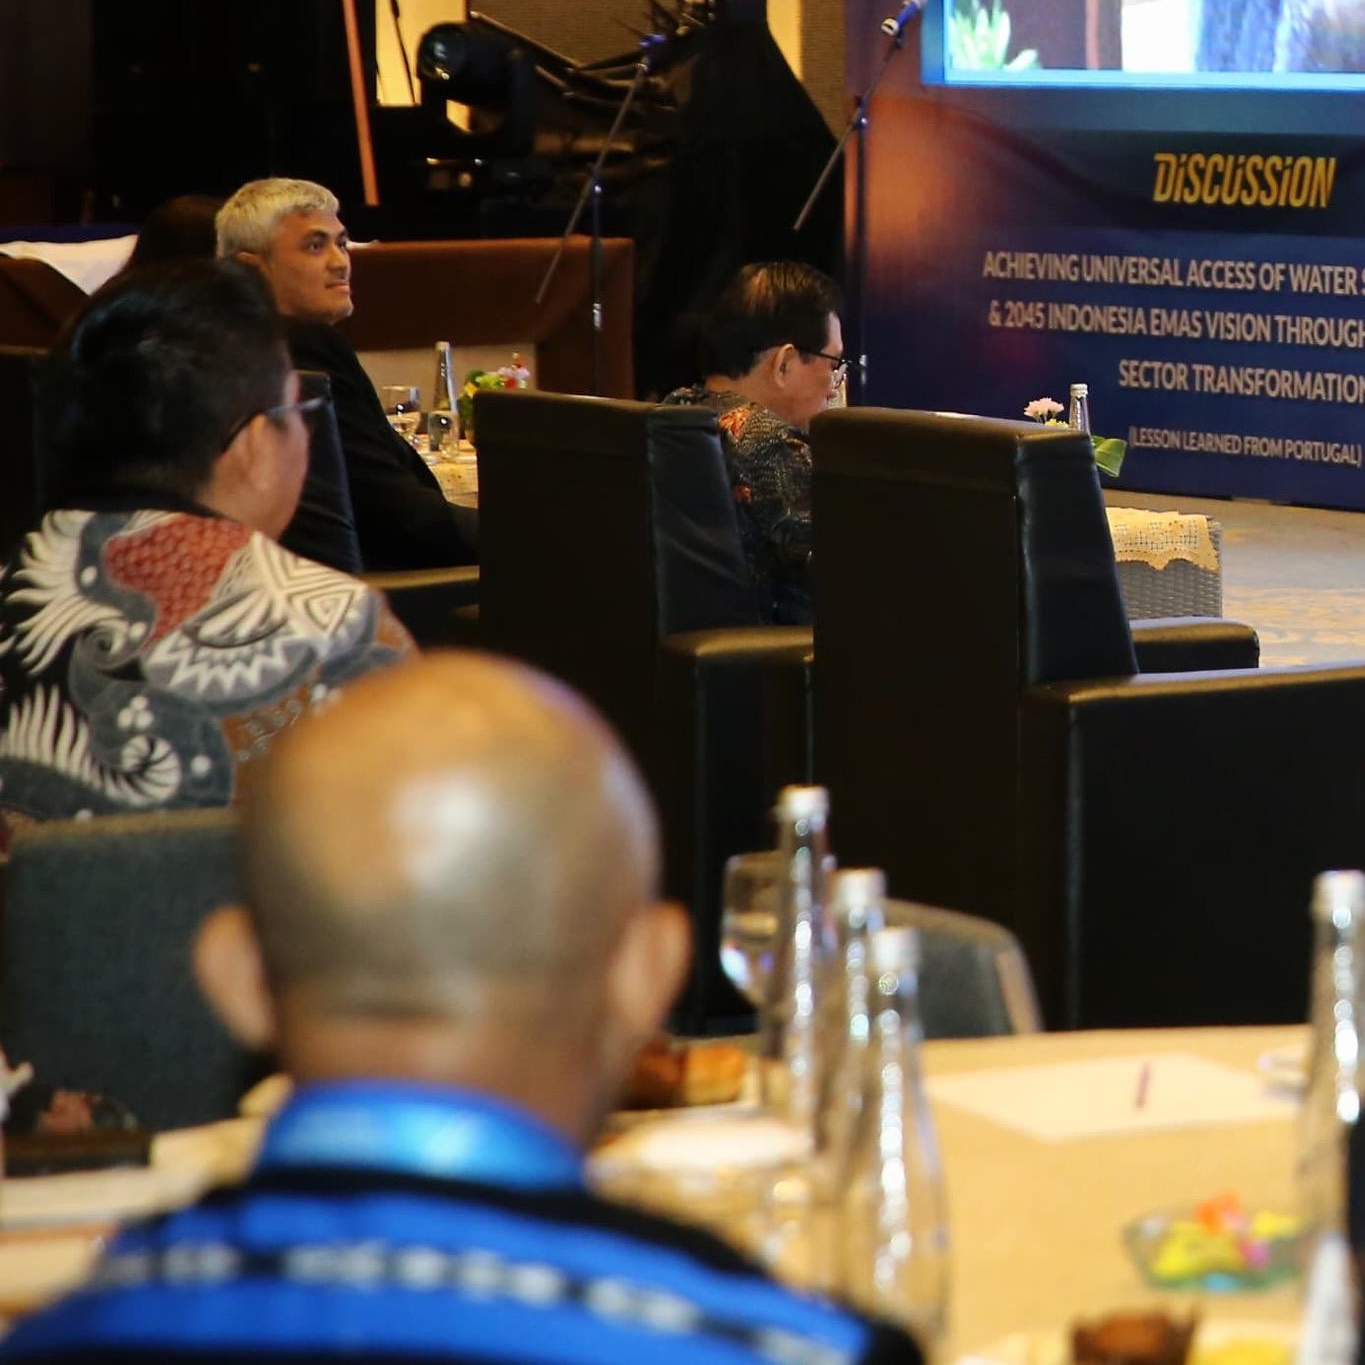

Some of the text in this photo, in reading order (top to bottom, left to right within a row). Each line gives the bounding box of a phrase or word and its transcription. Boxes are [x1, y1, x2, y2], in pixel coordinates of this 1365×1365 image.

[982, 251, 1079, 280] ACHIEVING
[1082, 255, 1184, 286] UNIVERSAL
[1186, 259, 1255, 290] ACCESS
[1259, 262, 1286, 291] OF
[1289, 264, 1357, 295] WATER
[988, 300, 1001, 327] &
[1004, 301, 1044, 329] 2045
[1049, 303, 1148, 335] INDONESIA
[1151, 308, 1202, 337] EMAS
[1205, 311, 1271, 342] VISION
[1119, 359, 1189, 391] SECTOR
[1129, 426, 1362, 468] (LESSON LEARNED FROM PORTUGAL)
